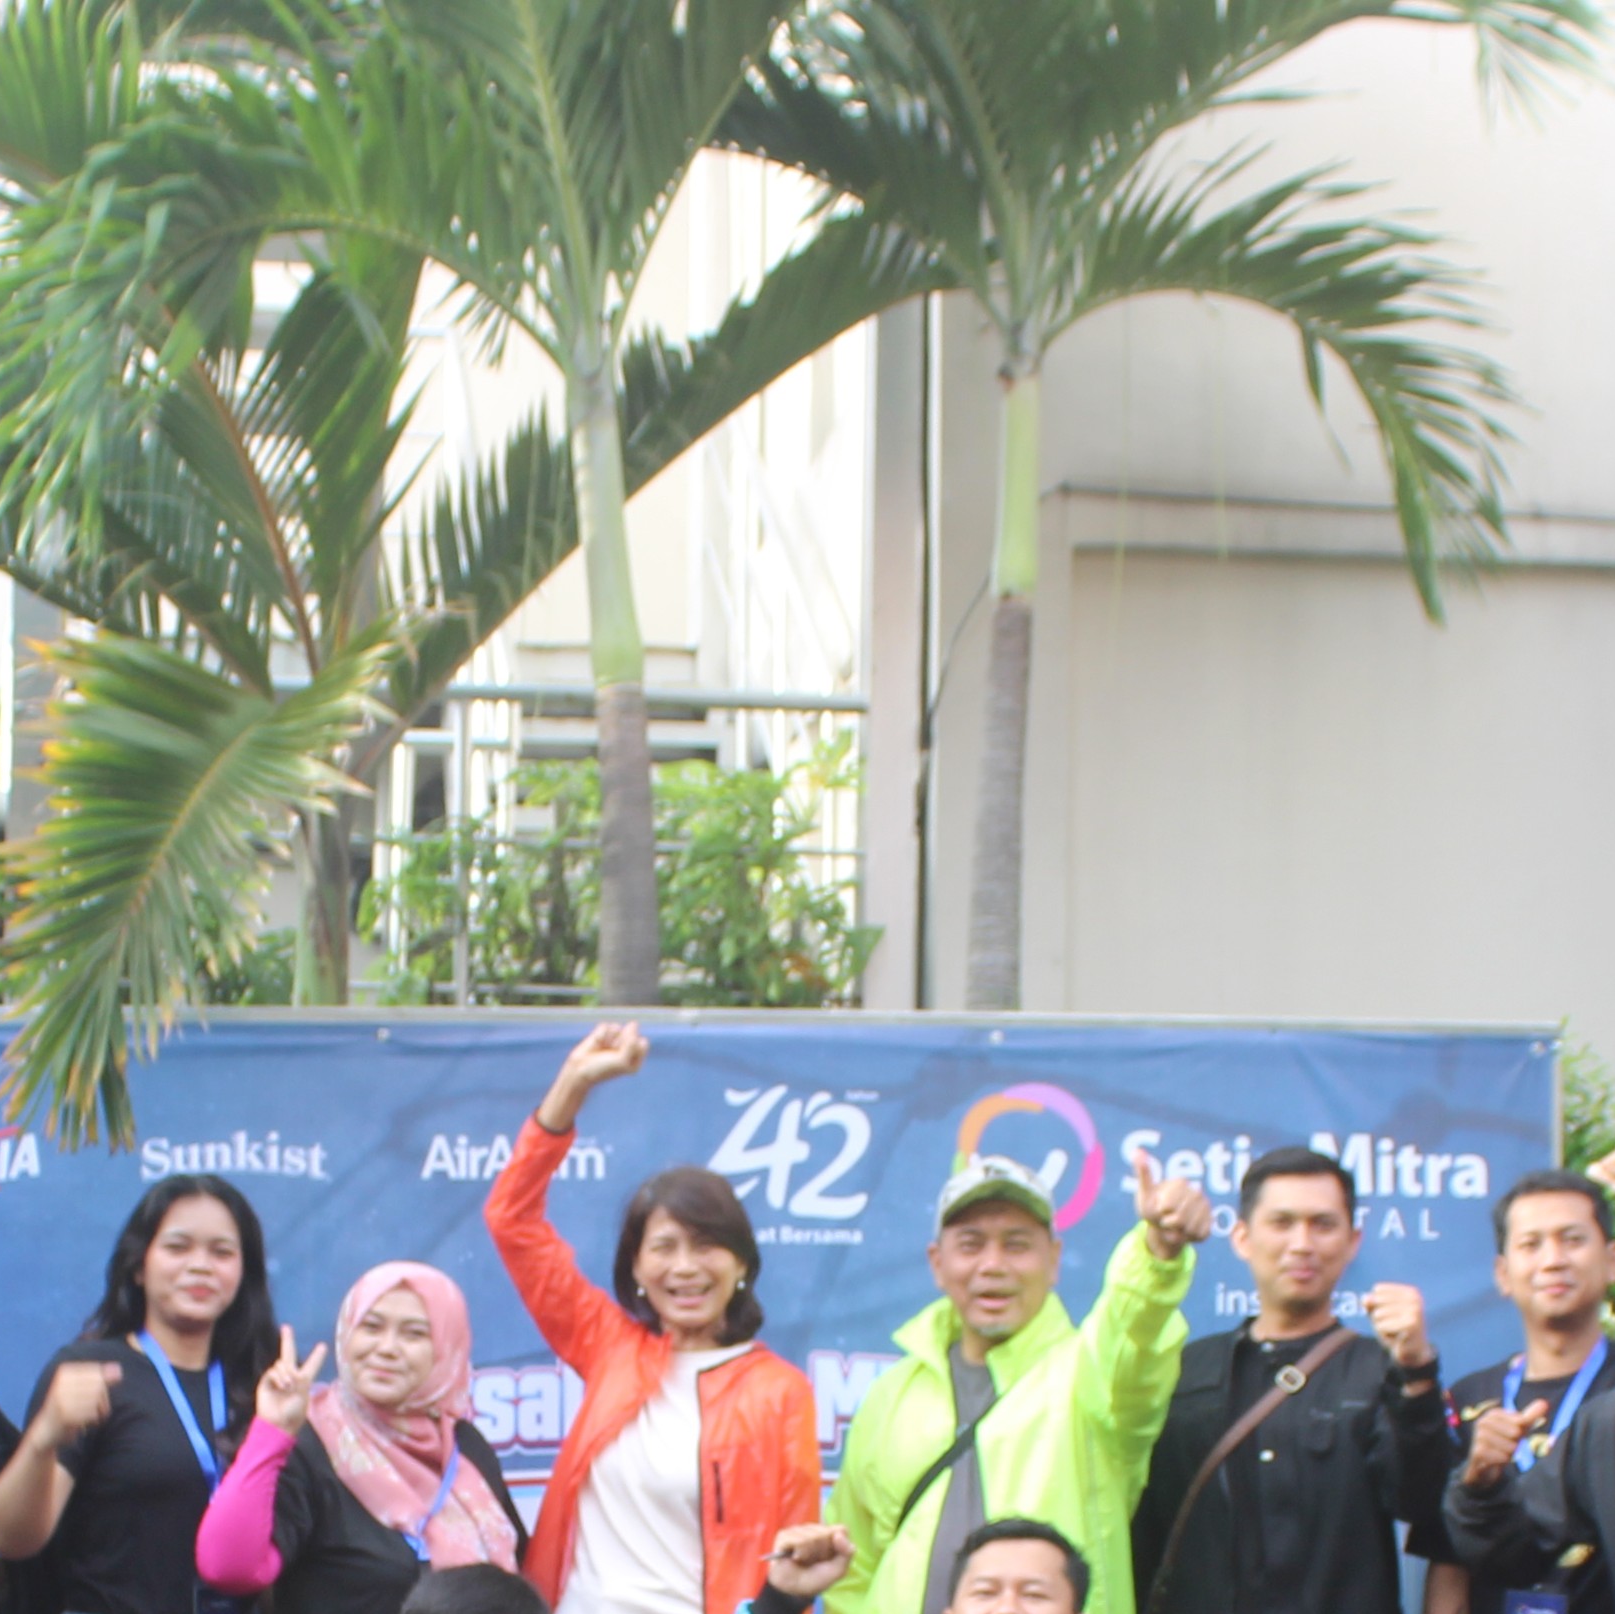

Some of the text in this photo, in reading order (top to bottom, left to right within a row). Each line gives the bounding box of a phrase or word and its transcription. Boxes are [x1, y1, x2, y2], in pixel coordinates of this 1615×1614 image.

[140, 1129, 334, 1184] Sunkist
[420, 1133, 607, 1181] AirAm
[707, 1083, 872, 1221] 42
[1119, 1129, 1491, 1198] Seti Mitra
[780, 1226, 864, 1245] Bersama
